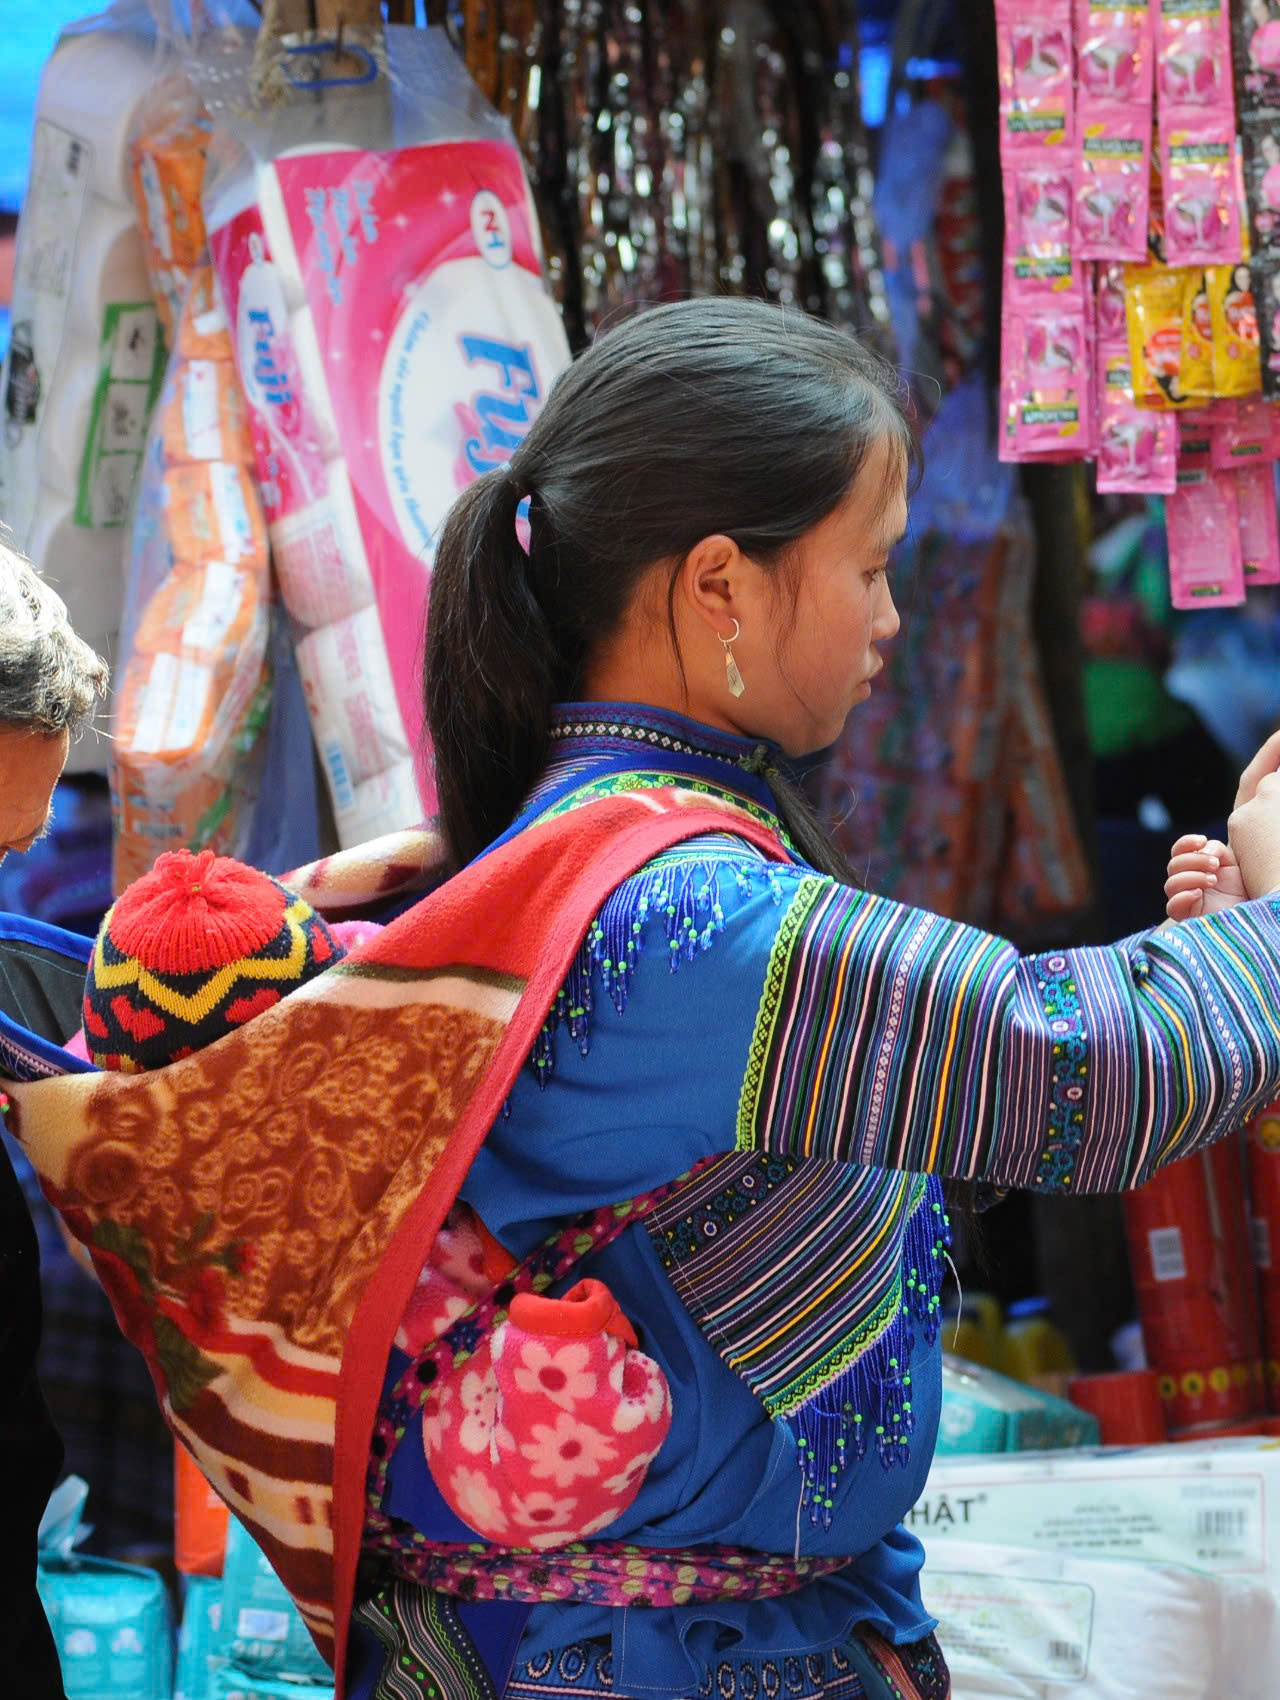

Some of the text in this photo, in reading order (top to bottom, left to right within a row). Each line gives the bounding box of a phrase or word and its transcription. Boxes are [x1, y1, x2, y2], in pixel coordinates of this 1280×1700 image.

[248, 310, 292, 404] Fuji
[459, 333, 541, 476] Fuj
[901, 1493, 975, 1533] HẬT
